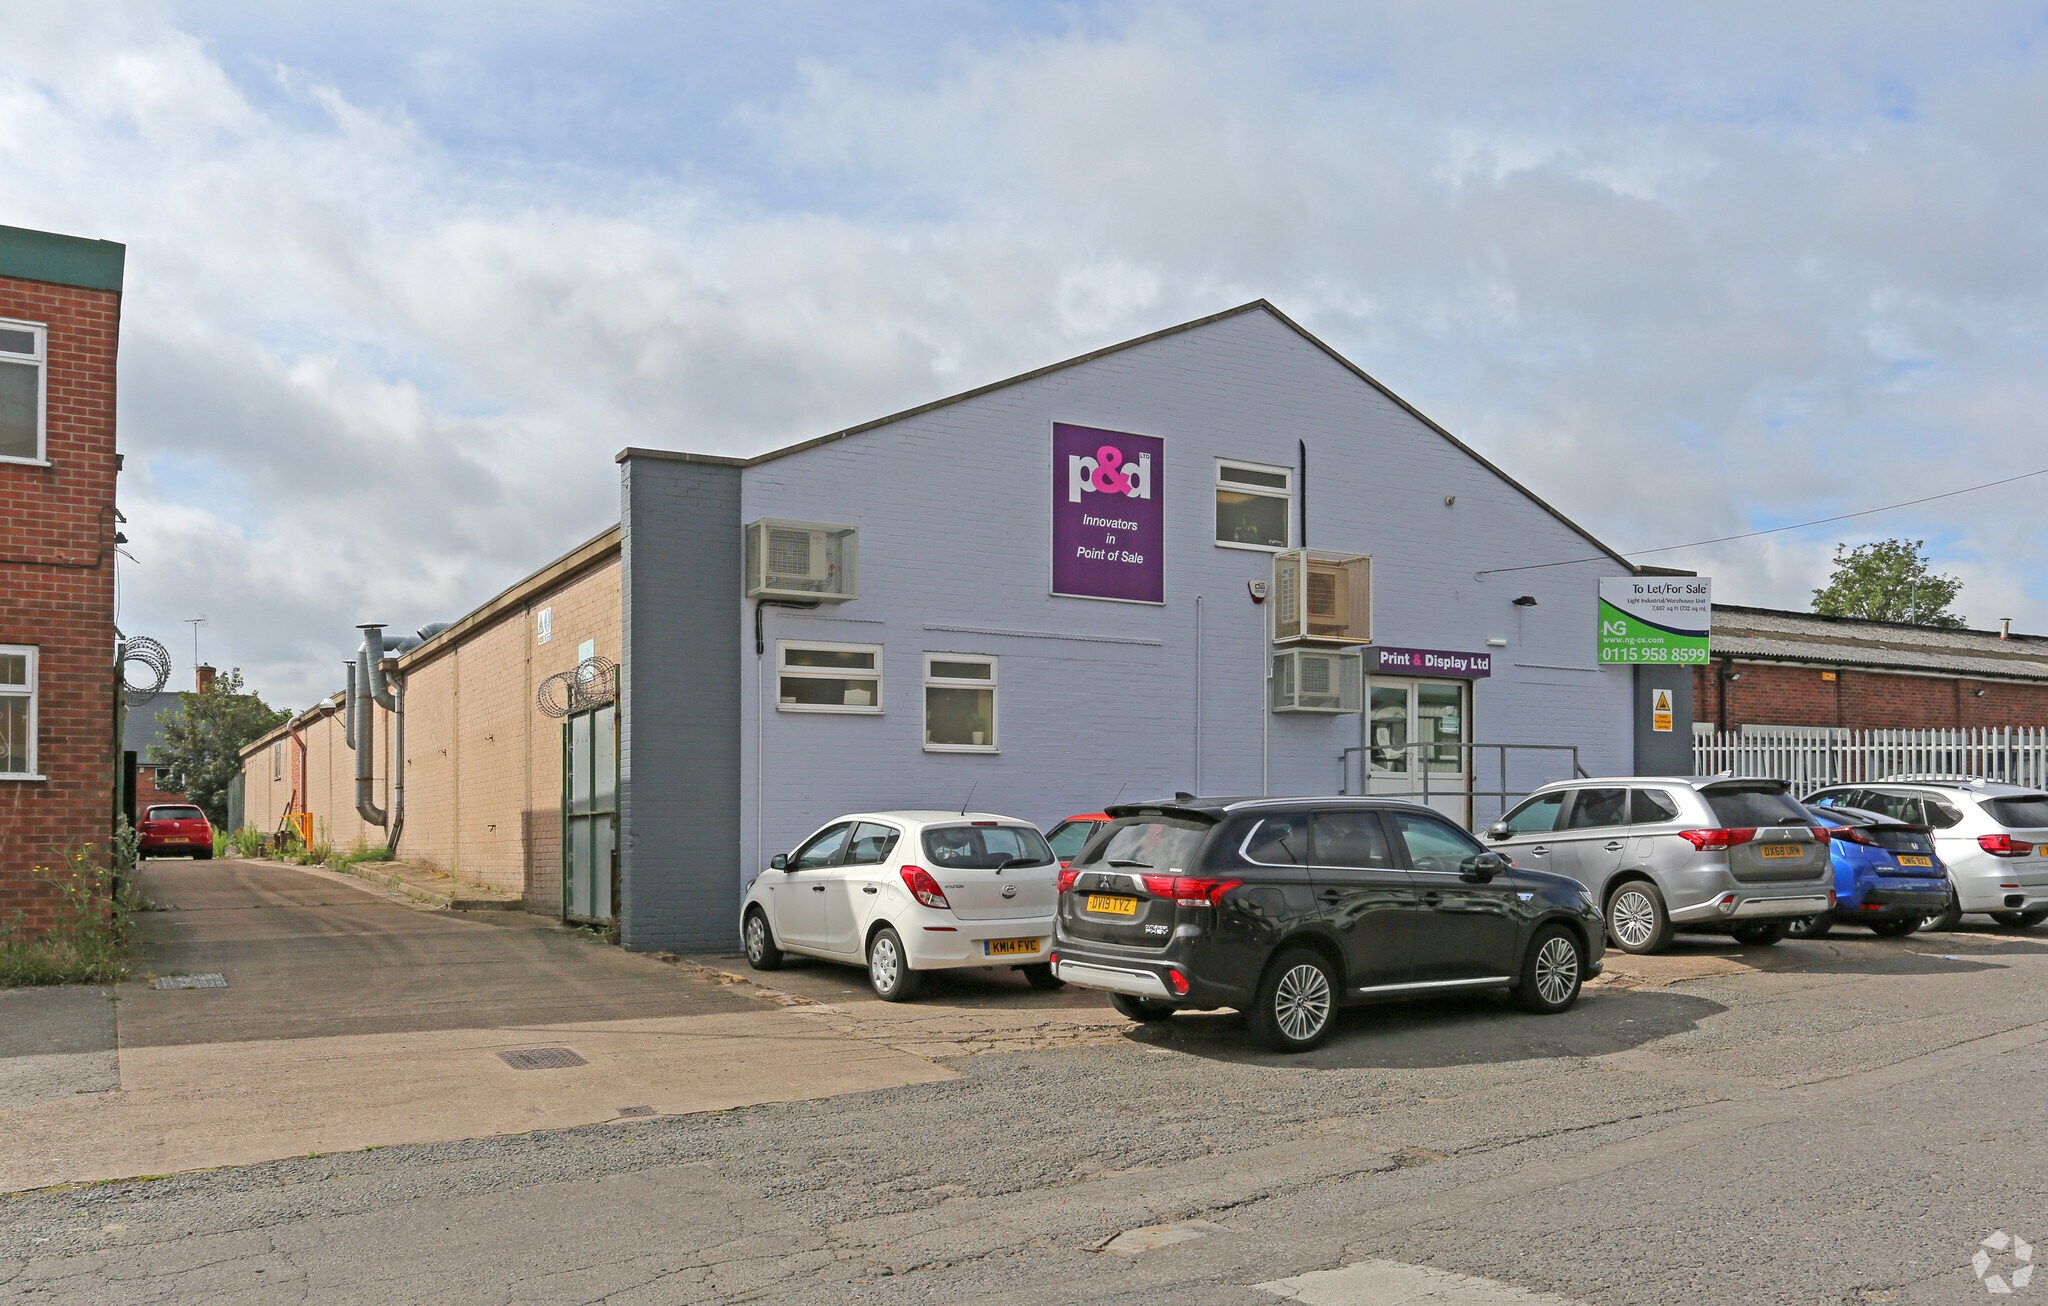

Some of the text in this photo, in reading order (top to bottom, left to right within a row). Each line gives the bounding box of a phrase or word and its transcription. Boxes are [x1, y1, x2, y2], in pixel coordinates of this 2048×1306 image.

[1069, 445, 1151, 503] p&d
[1083, 514, 1138, 530] Innovators
[1105, 533, 1115, 544] in
[1077, 547, 1143, 564] Point of Sale
[1633, 583, 1706, 595] To Let/For Sale
[1603, 620, 1627, 636] NG
[1603, 637, 1664, 645] www.ng-cs.com
[1380, 651, 1489, 671] Print & Display Ltd
[1603, 647, 1705, 662] 0115 958 8599
[1764, 846, 1785, 857] DX68
[1092, 896, 1132, 912] DV19 TYZ
[992, 939, 1037, 953] KM14 FVC
